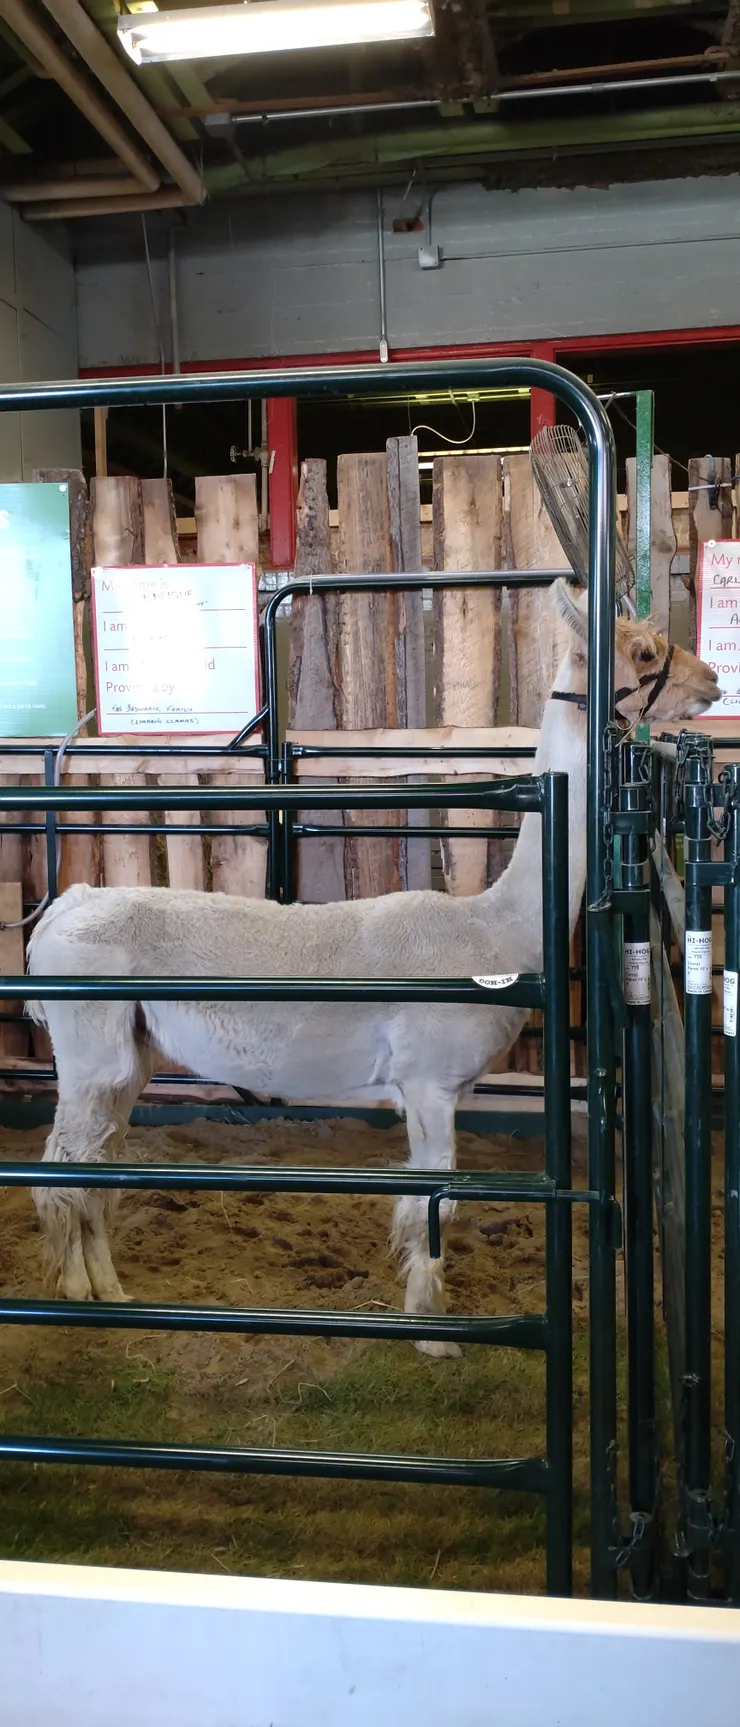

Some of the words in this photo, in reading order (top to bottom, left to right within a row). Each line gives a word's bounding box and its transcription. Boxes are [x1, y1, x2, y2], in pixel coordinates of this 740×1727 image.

[711, 553, 733, 569] My
[710, 597, 713, 608] I
[717, 599, 738, 608] am
[110, 621, 128, 632] am
[708, 639, 712, 651] I
[716, 642, 737, 651] am
[105, 660, 108, 672] I
[112, 662, 129, 672] am
